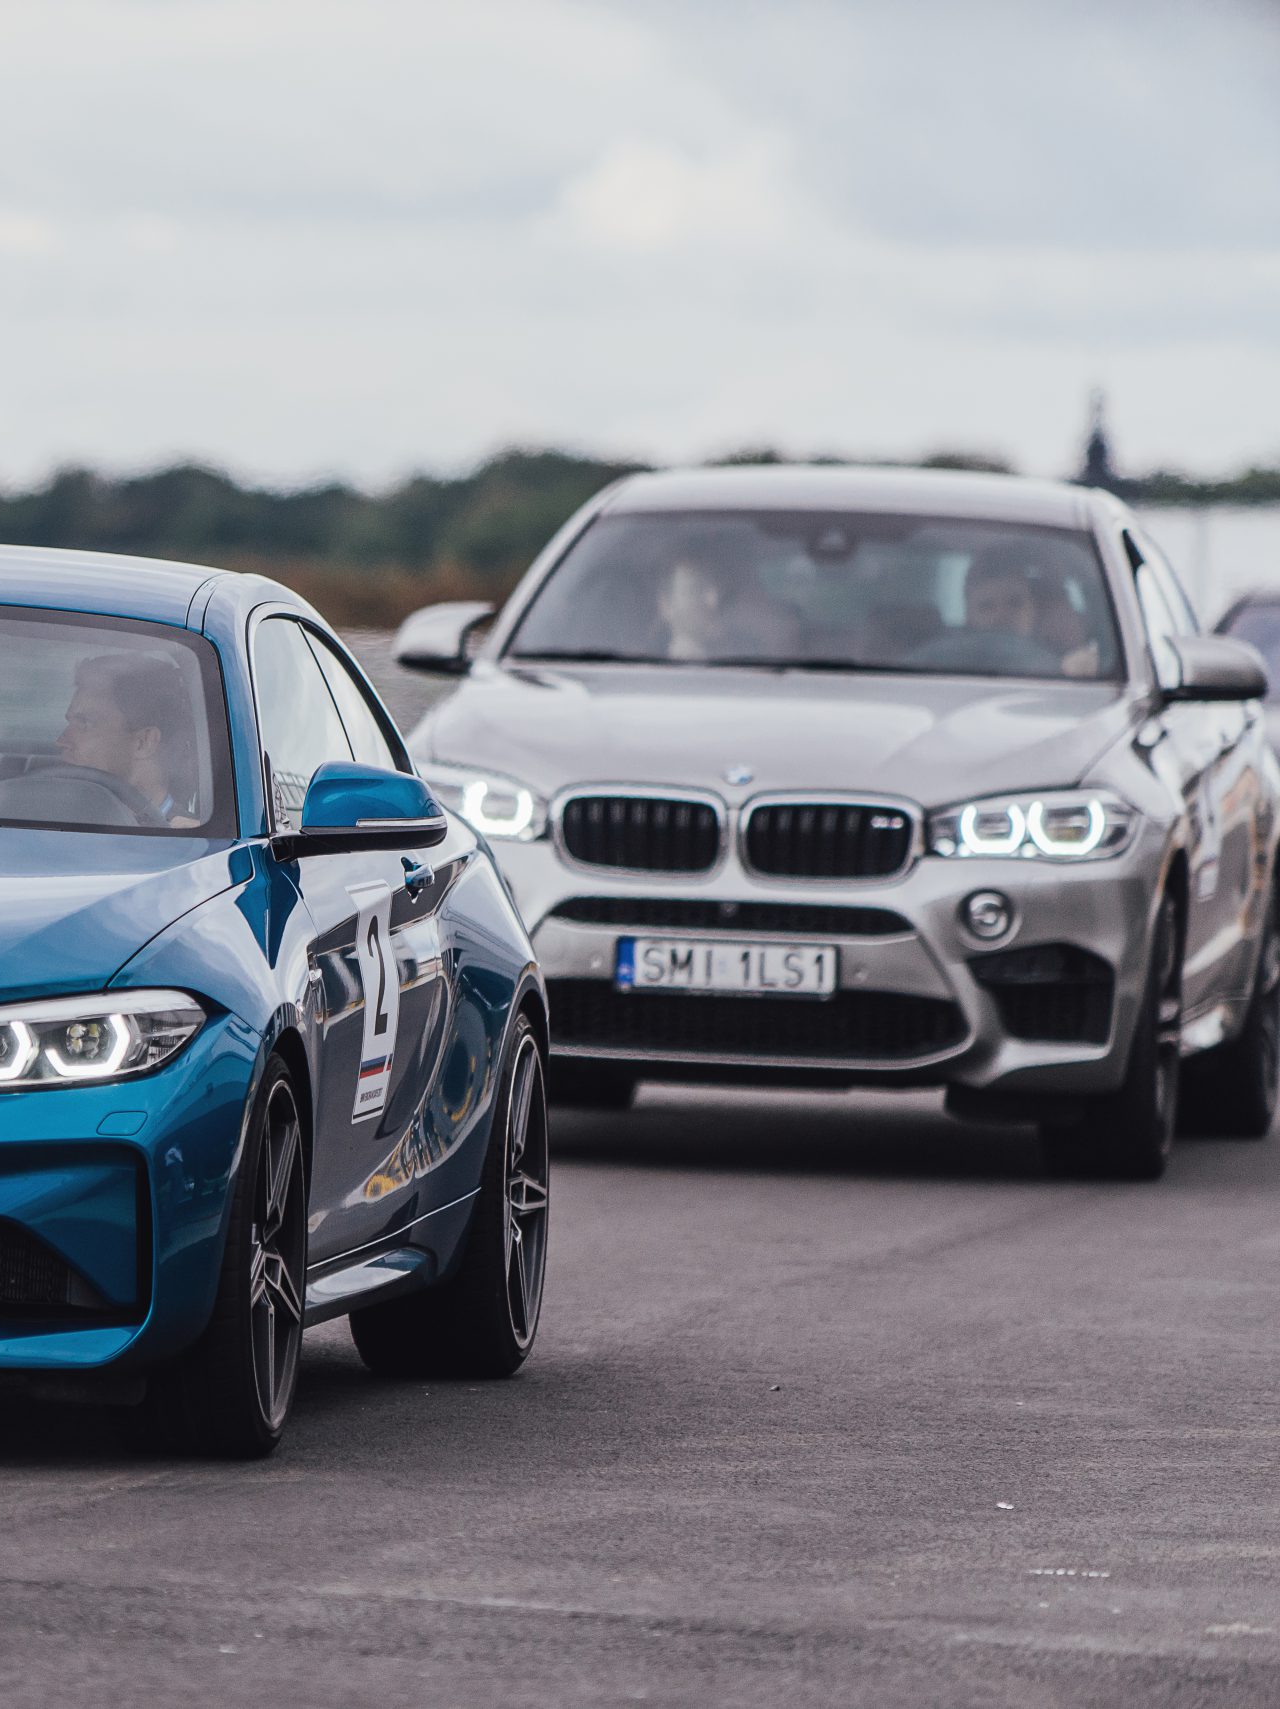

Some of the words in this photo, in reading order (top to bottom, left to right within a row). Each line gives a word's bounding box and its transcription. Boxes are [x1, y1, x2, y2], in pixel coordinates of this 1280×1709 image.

[367, 914, 388, 1036] 2
[643, 947, 712, 985] SMI
[741, 951, 824, 990] 1LS1
